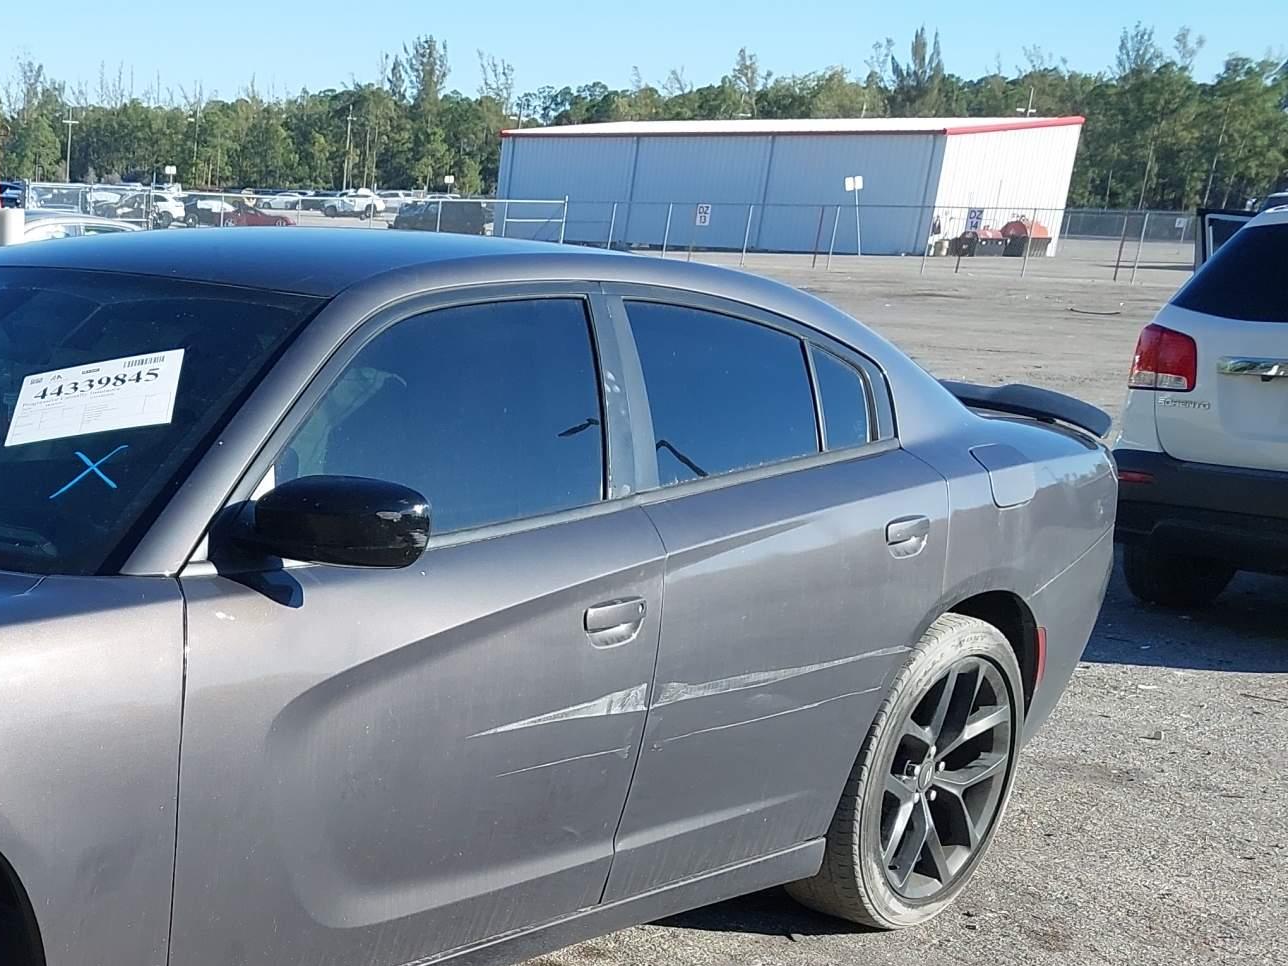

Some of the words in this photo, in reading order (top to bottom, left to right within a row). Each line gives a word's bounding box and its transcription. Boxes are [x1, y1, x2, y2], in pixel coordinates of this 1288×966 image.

[698, 205, 710, 215] DZ
[969, 210, 983, 220] DZ
[969, 221, 979, 230] 14
[33, 367, 160, 400] 44339845
